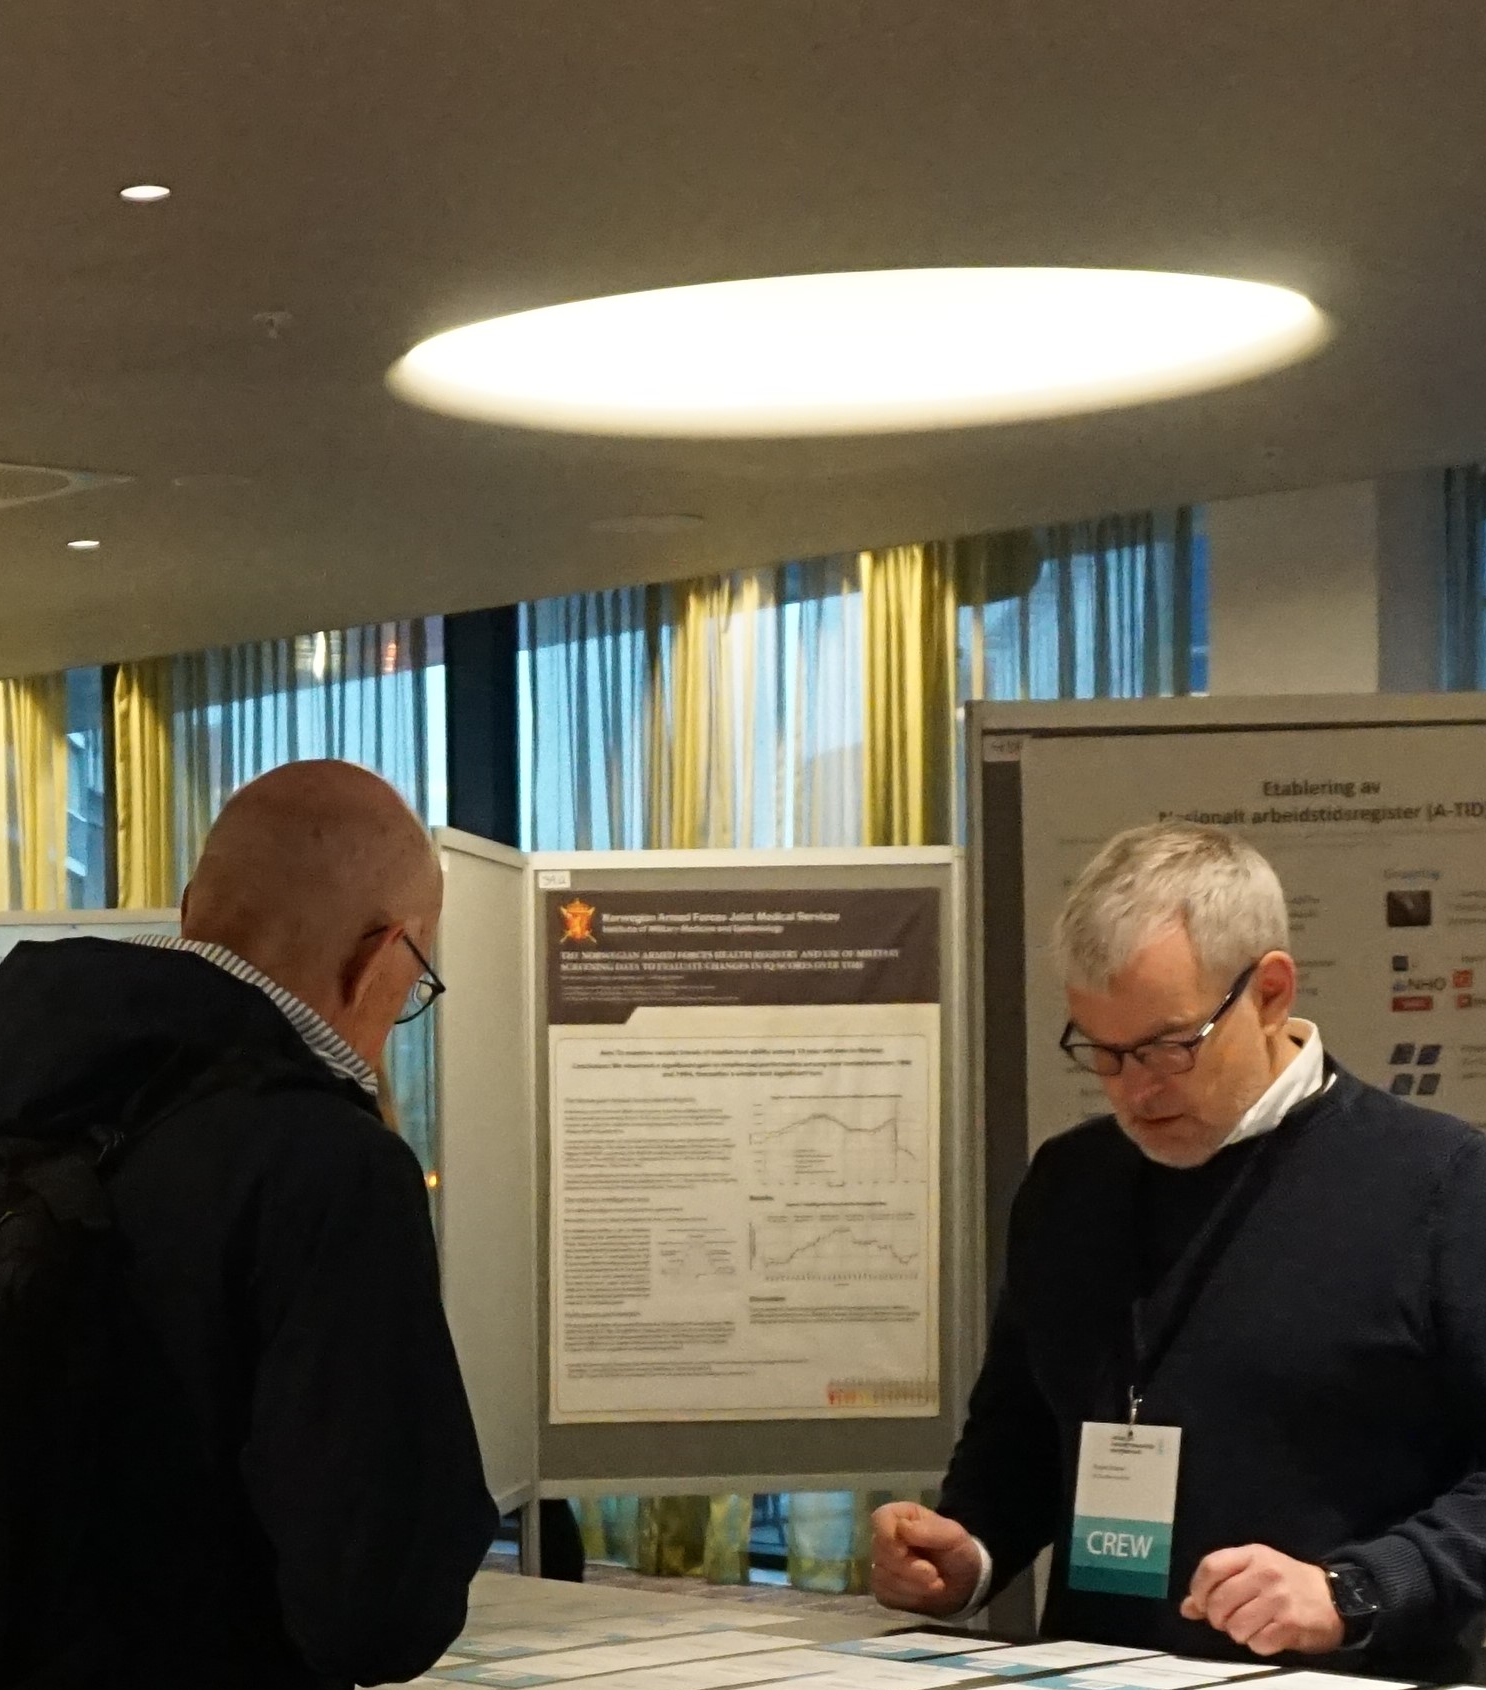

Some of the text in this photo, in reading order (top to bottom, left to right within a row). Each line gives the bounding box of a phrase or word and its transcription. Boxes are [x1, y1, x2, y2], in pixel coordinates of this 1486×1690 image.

[1263, 780, 1381, 797] Etablering av
[1086, 1530, 1154, 1559] CREW
